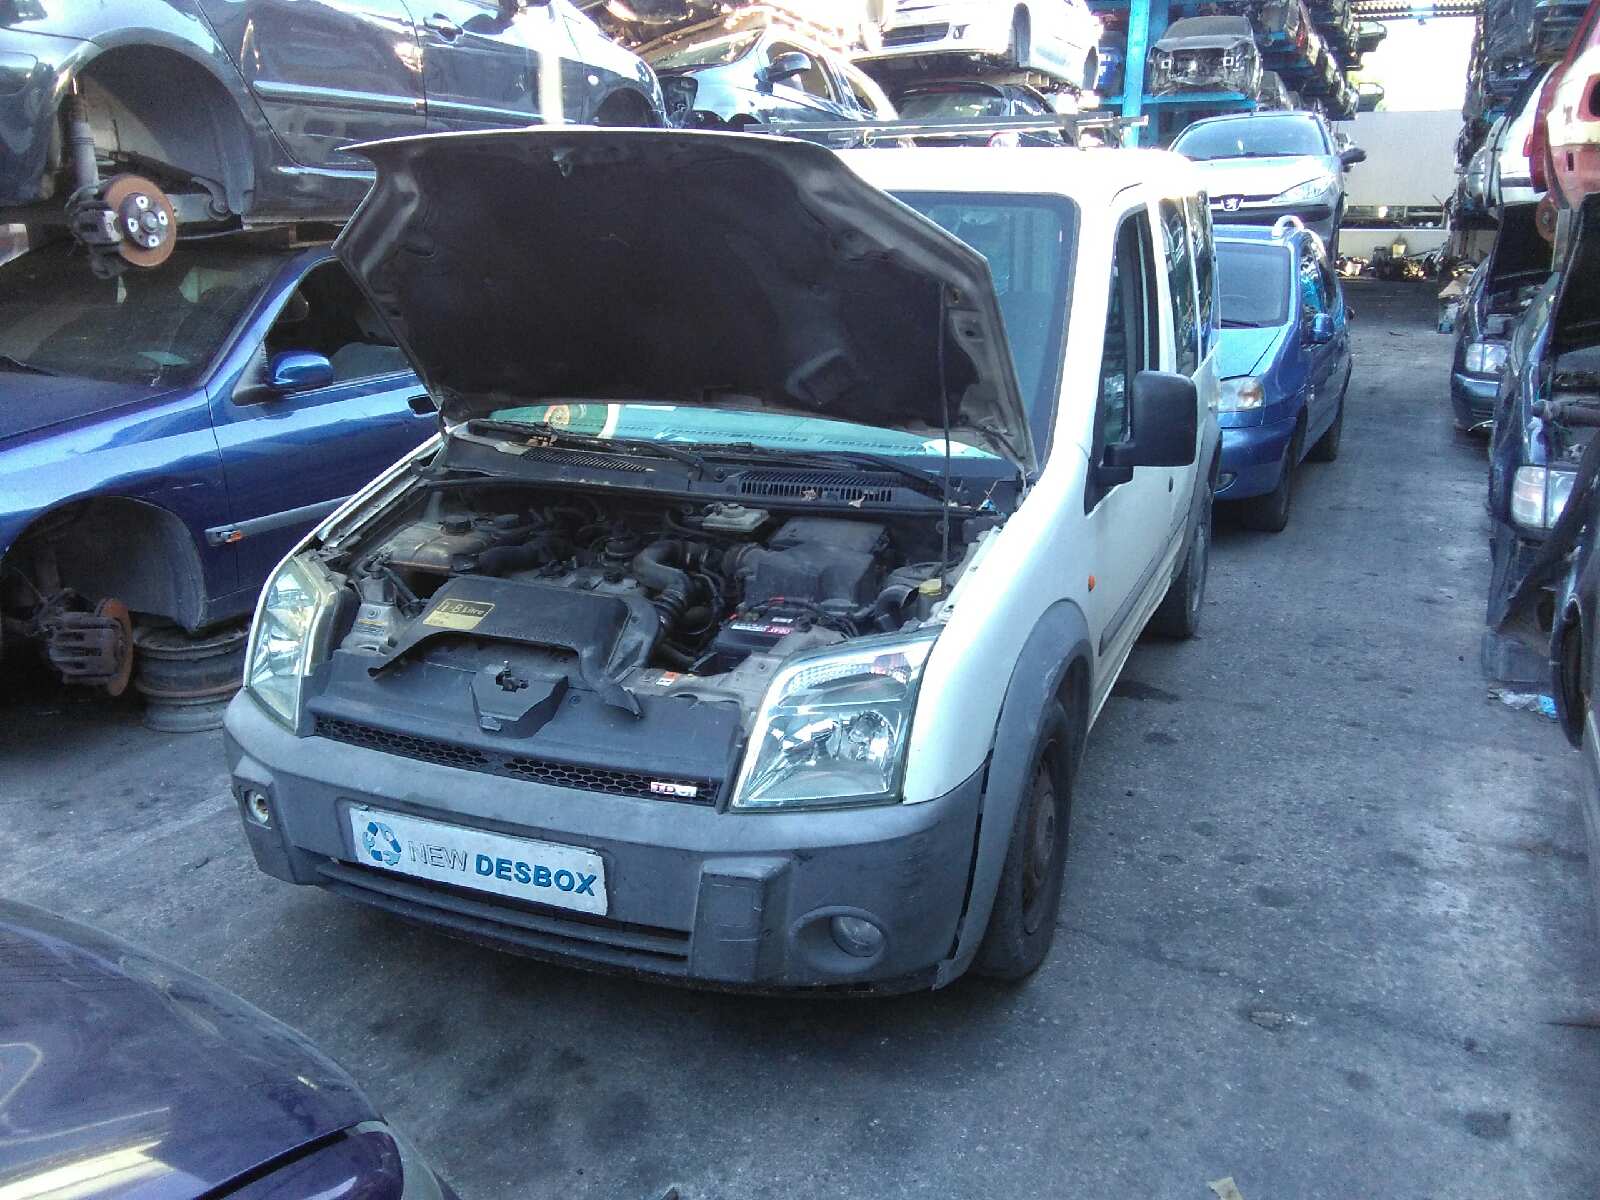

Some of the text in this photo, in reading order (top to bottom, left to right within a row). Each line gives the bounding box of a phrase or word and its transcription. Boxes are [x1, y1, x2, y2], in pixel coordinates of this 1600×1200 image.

[651, 782, 697, 798] TD
[407, 840, 598, 897] NEW DESBOX
